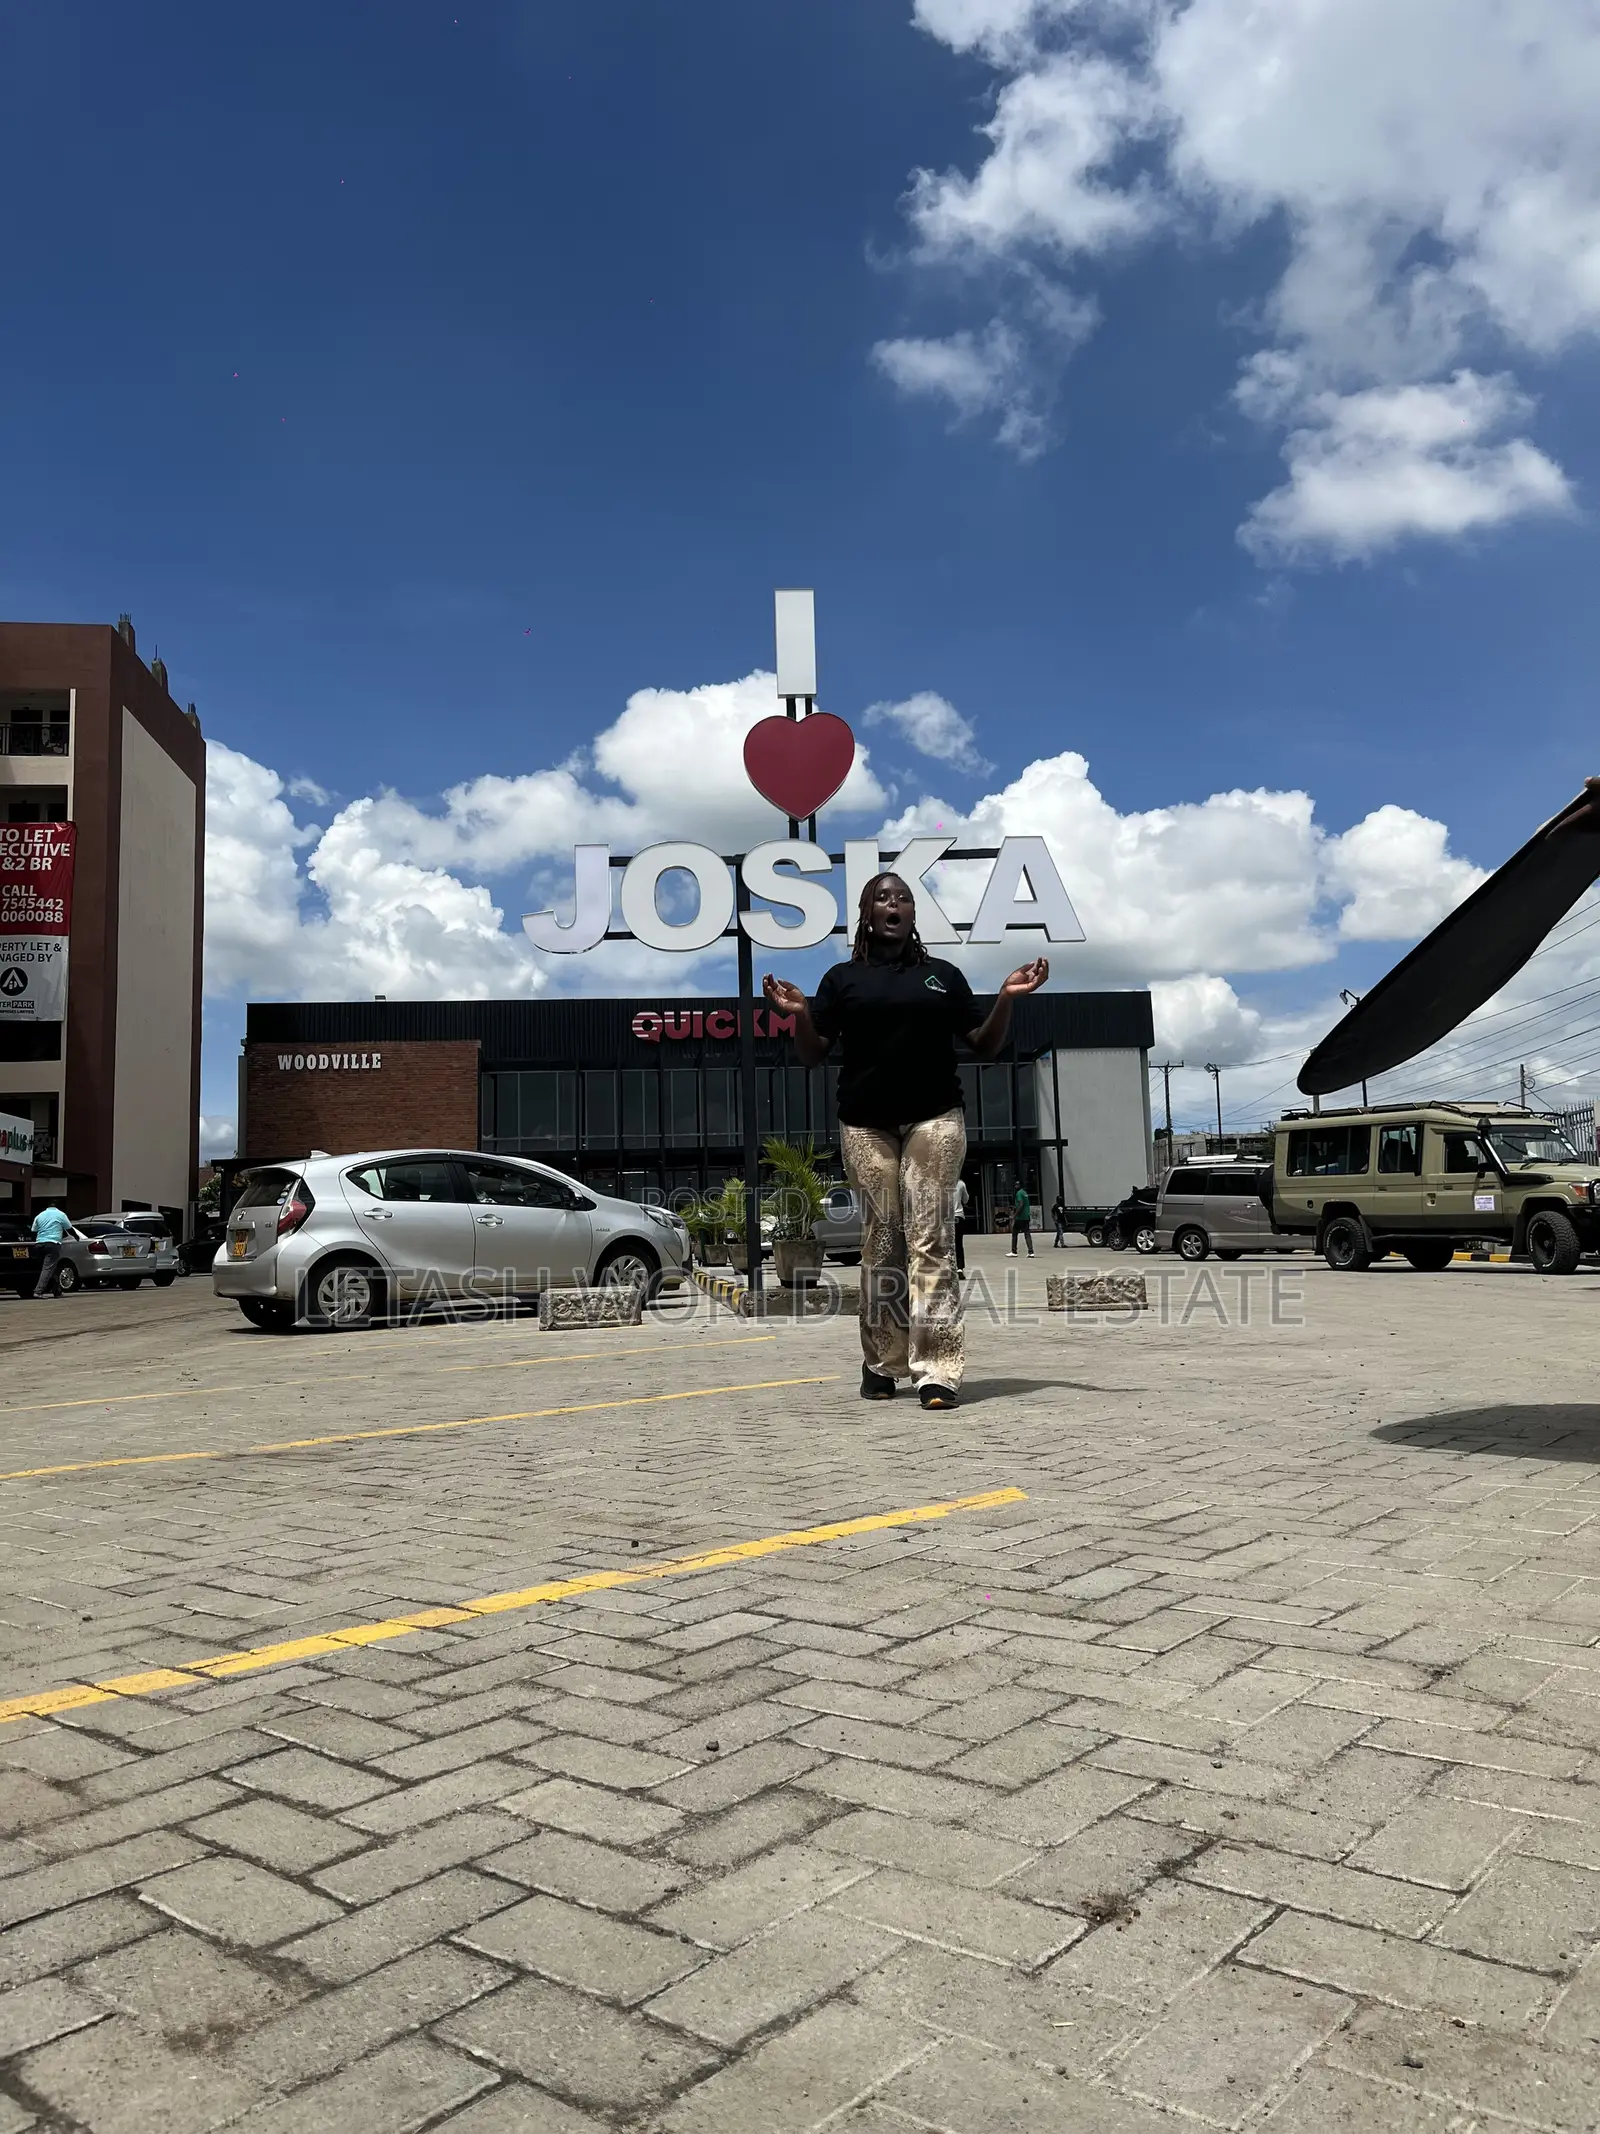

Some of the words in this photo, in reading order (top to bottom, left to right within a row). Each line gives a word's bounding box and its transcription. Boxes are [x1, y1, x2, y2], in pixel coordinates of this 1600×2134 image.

[774, 587, 817, 697] I
[24, 829, 55, 843] LET
[0, 843, 71, 857] ECUTIVE
[30, 857, 53, 871] BR
[2, 885, 38, 897] CALL
[521, 836, 1086, 953] JOSKA
[2, 897, 64, 911] 7545442
[1, 910, 64, 923] 0060088
[0, 942, 27, 952] ERTY
[30, 942, 51, 952] LET
[53, 943, 62, 953] &
[38, 953, 53, 963] BY
[631, 1008, 797, 1044] QUICKM
[277, 1053, 381, 1070] WOODVILLE
